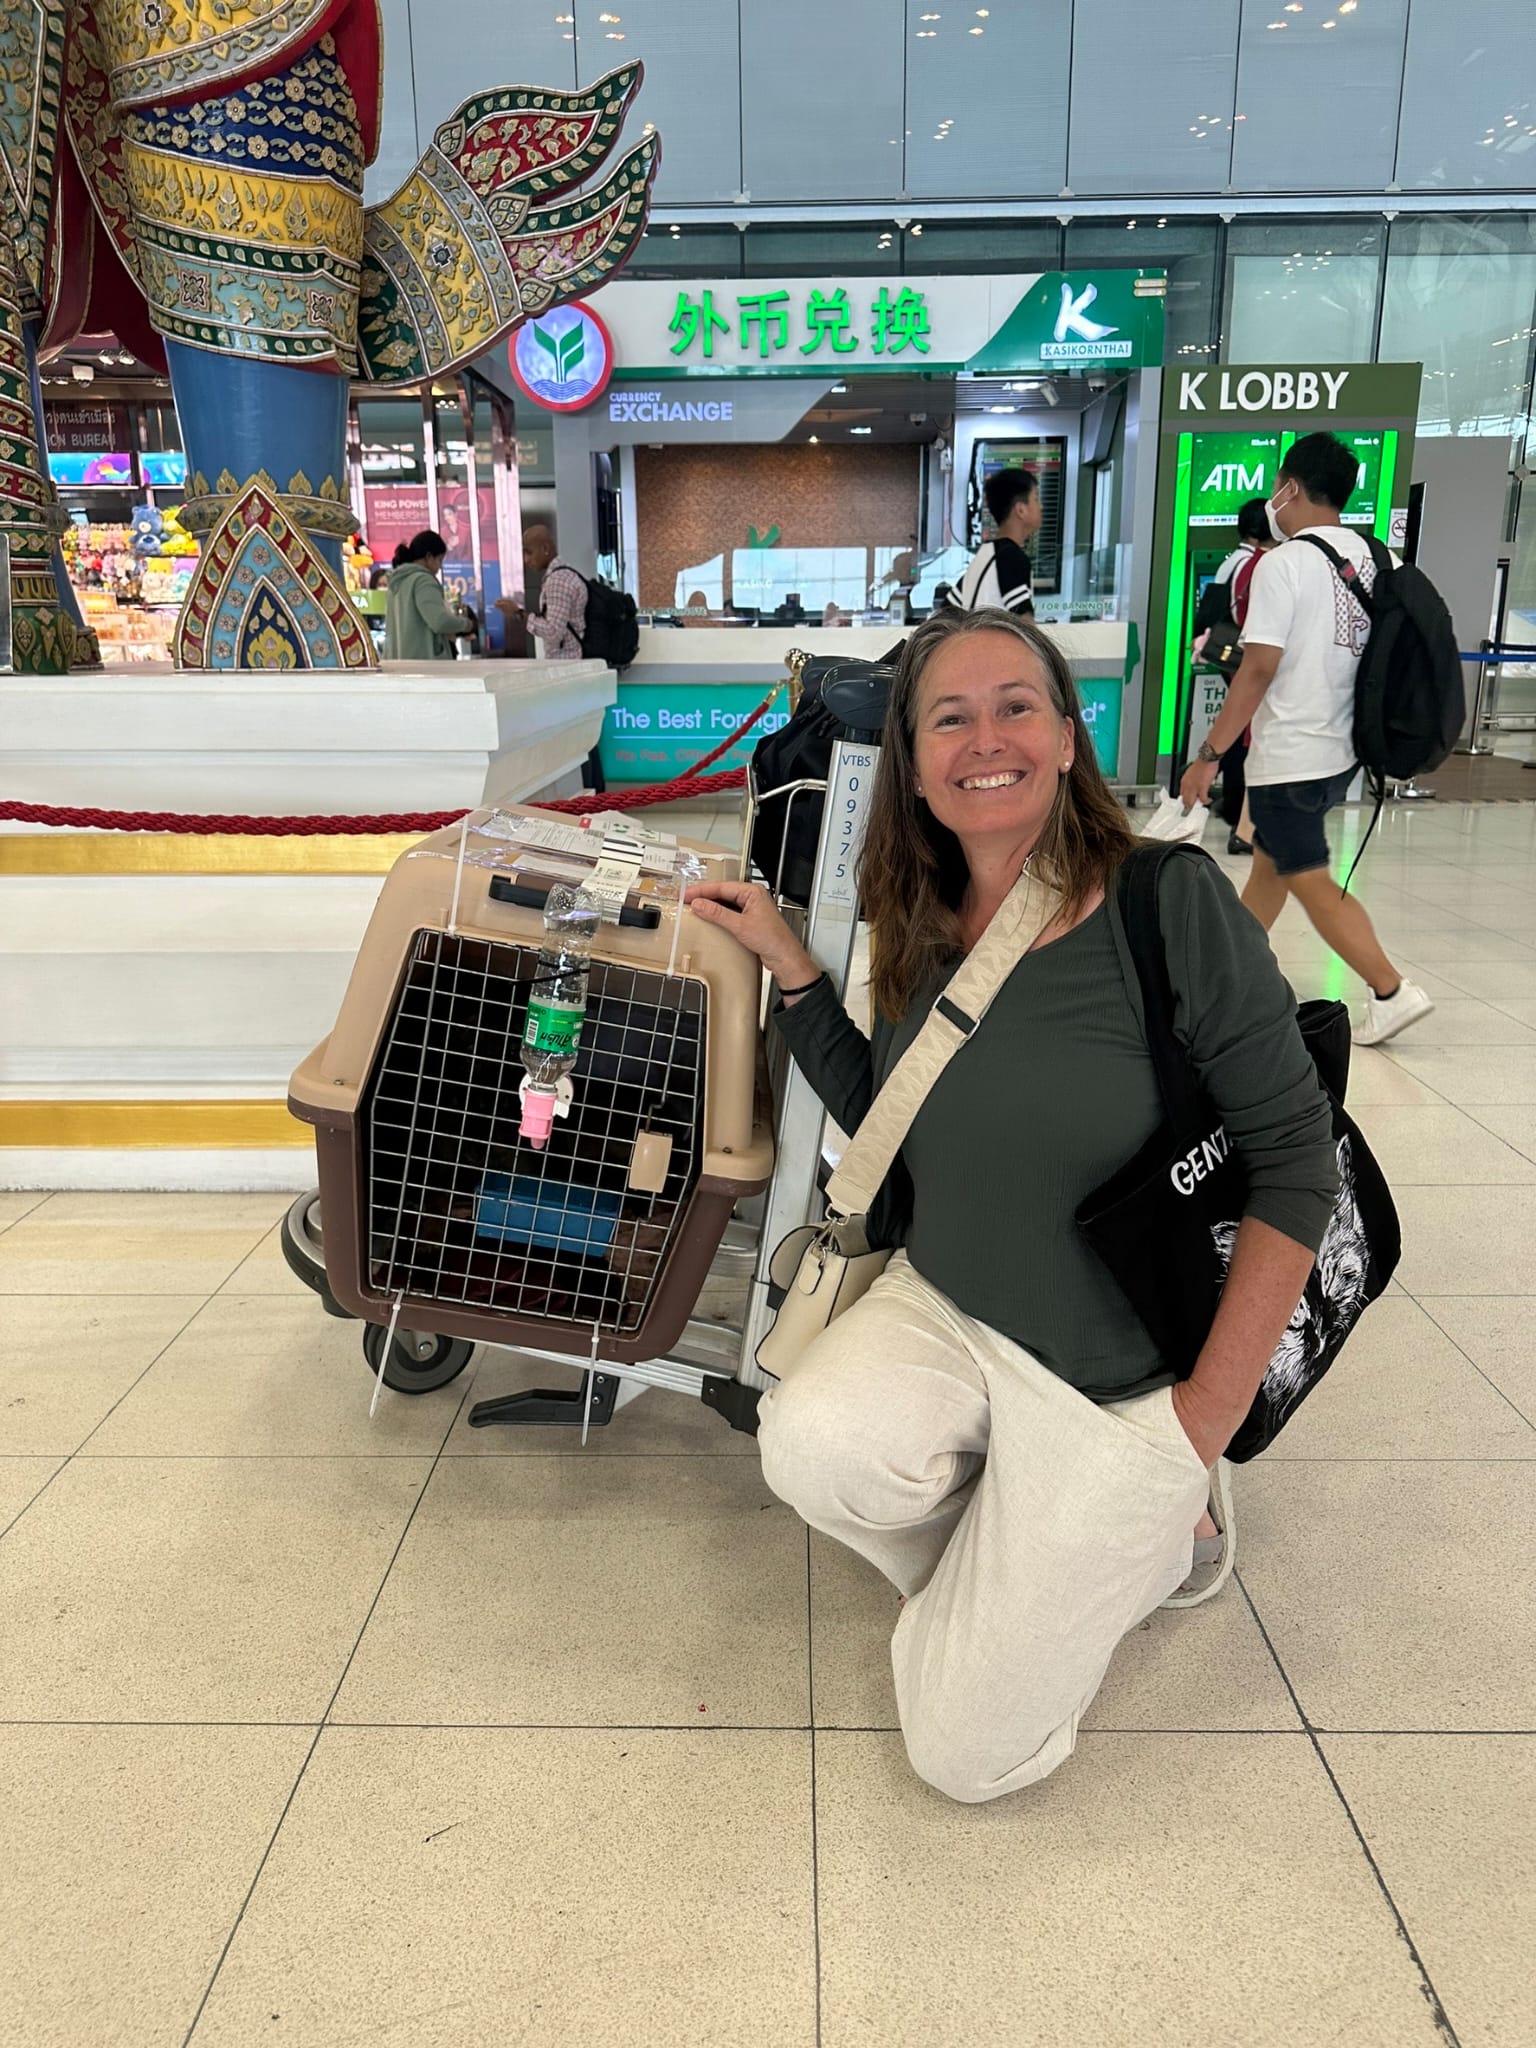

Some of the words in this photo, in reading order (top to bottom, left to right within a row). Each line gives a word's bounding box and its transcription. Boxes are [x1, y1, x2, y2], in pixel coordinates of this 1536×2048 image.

[668, 286, 931, 358] 外币兑换
[1044, 343, 1129, 357] KASIKORNTHAI
[609, 392, 661, 402] CURRENCY
[1179, 372, 1208, 410] K
[1219, 371, 1350, 411] LOBBY
[609, 401, 733, 422] EXCHANGE
[1200, 463, 1265, 492] ATM
[612, 708, 650, 728] The
[658, 709, 702, 728] Best
[842, 755, 871, 767] VTBS
[1170, 1125, 1233, 1196] GENT
